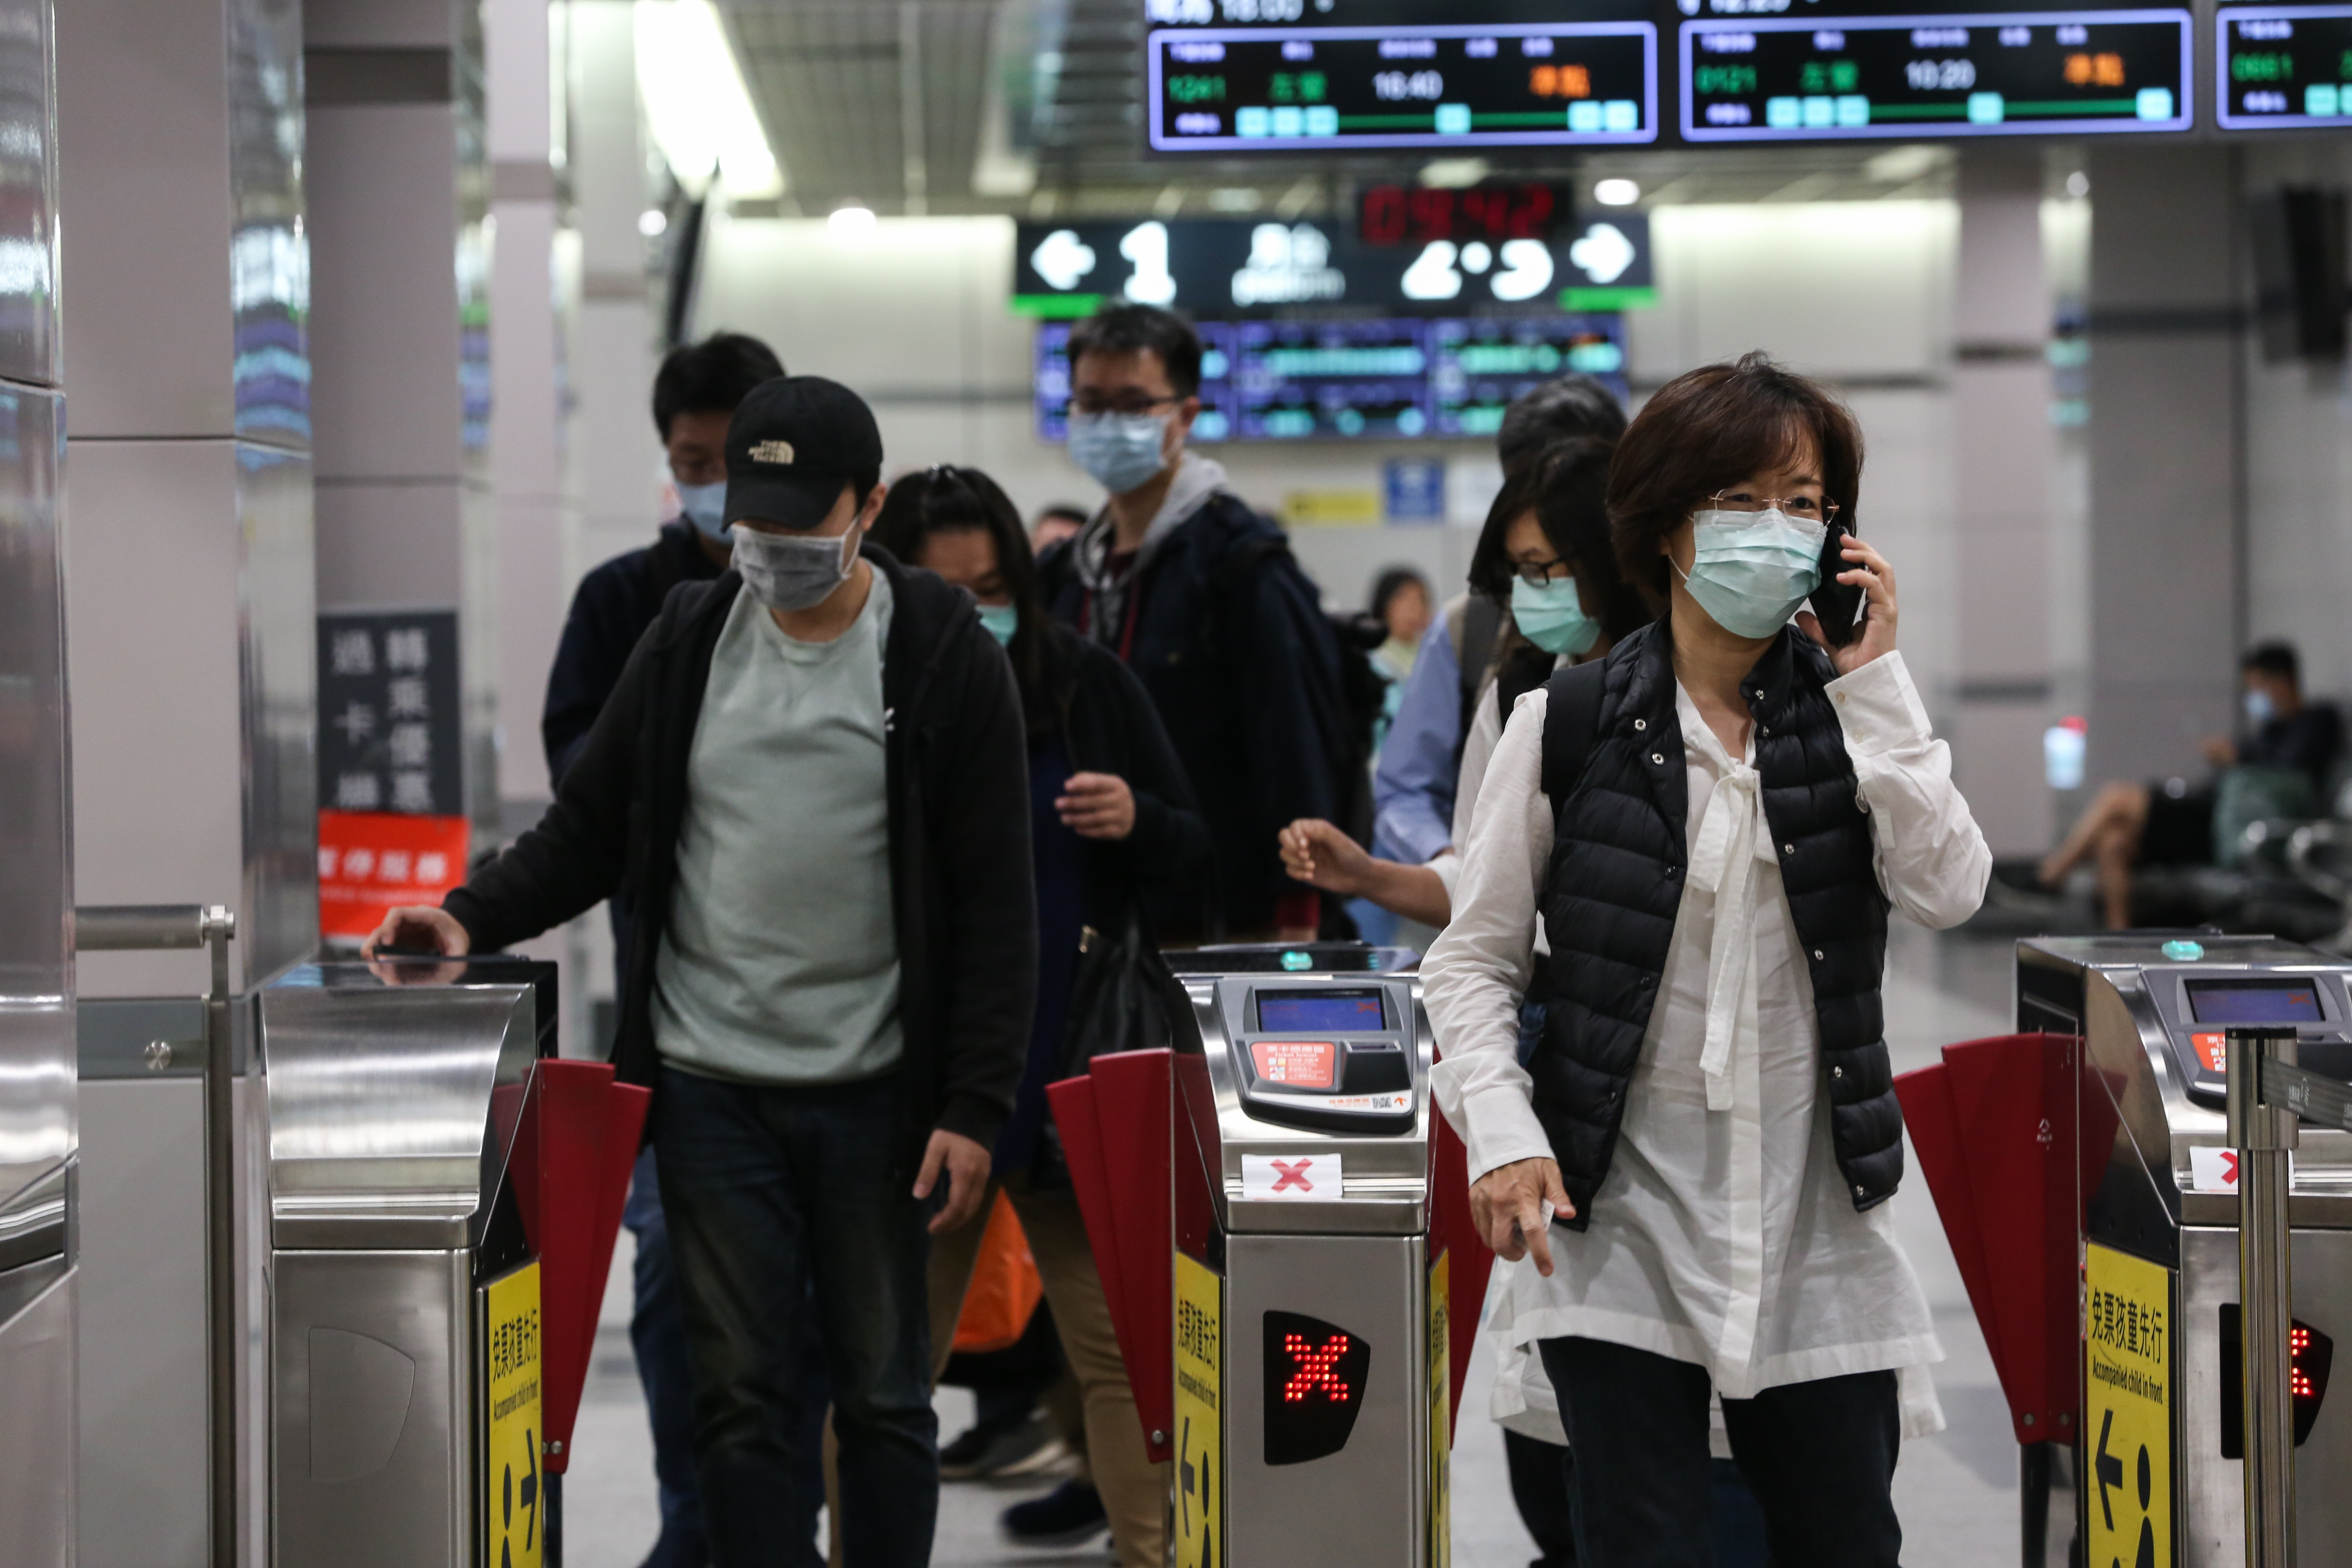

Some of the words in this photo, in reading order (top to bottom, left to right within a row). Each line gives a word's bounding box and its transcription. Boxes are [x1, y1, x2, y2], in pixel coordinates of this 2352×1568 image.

[1372, 70, 1443, 101] 16:40
[1904, 58, 1976, 90] 10:20
[1119, 220, 1176, 305] 1
[2092, 1287, 2162, 1364] 免票孩童先行
[2093, 1355, 2127, 1390] Accompanied
[2128, 1368, 2141, 1395] child
[2143, 1372, 2148, 1398] in
[2149, 1375, 2162, 1404] front
